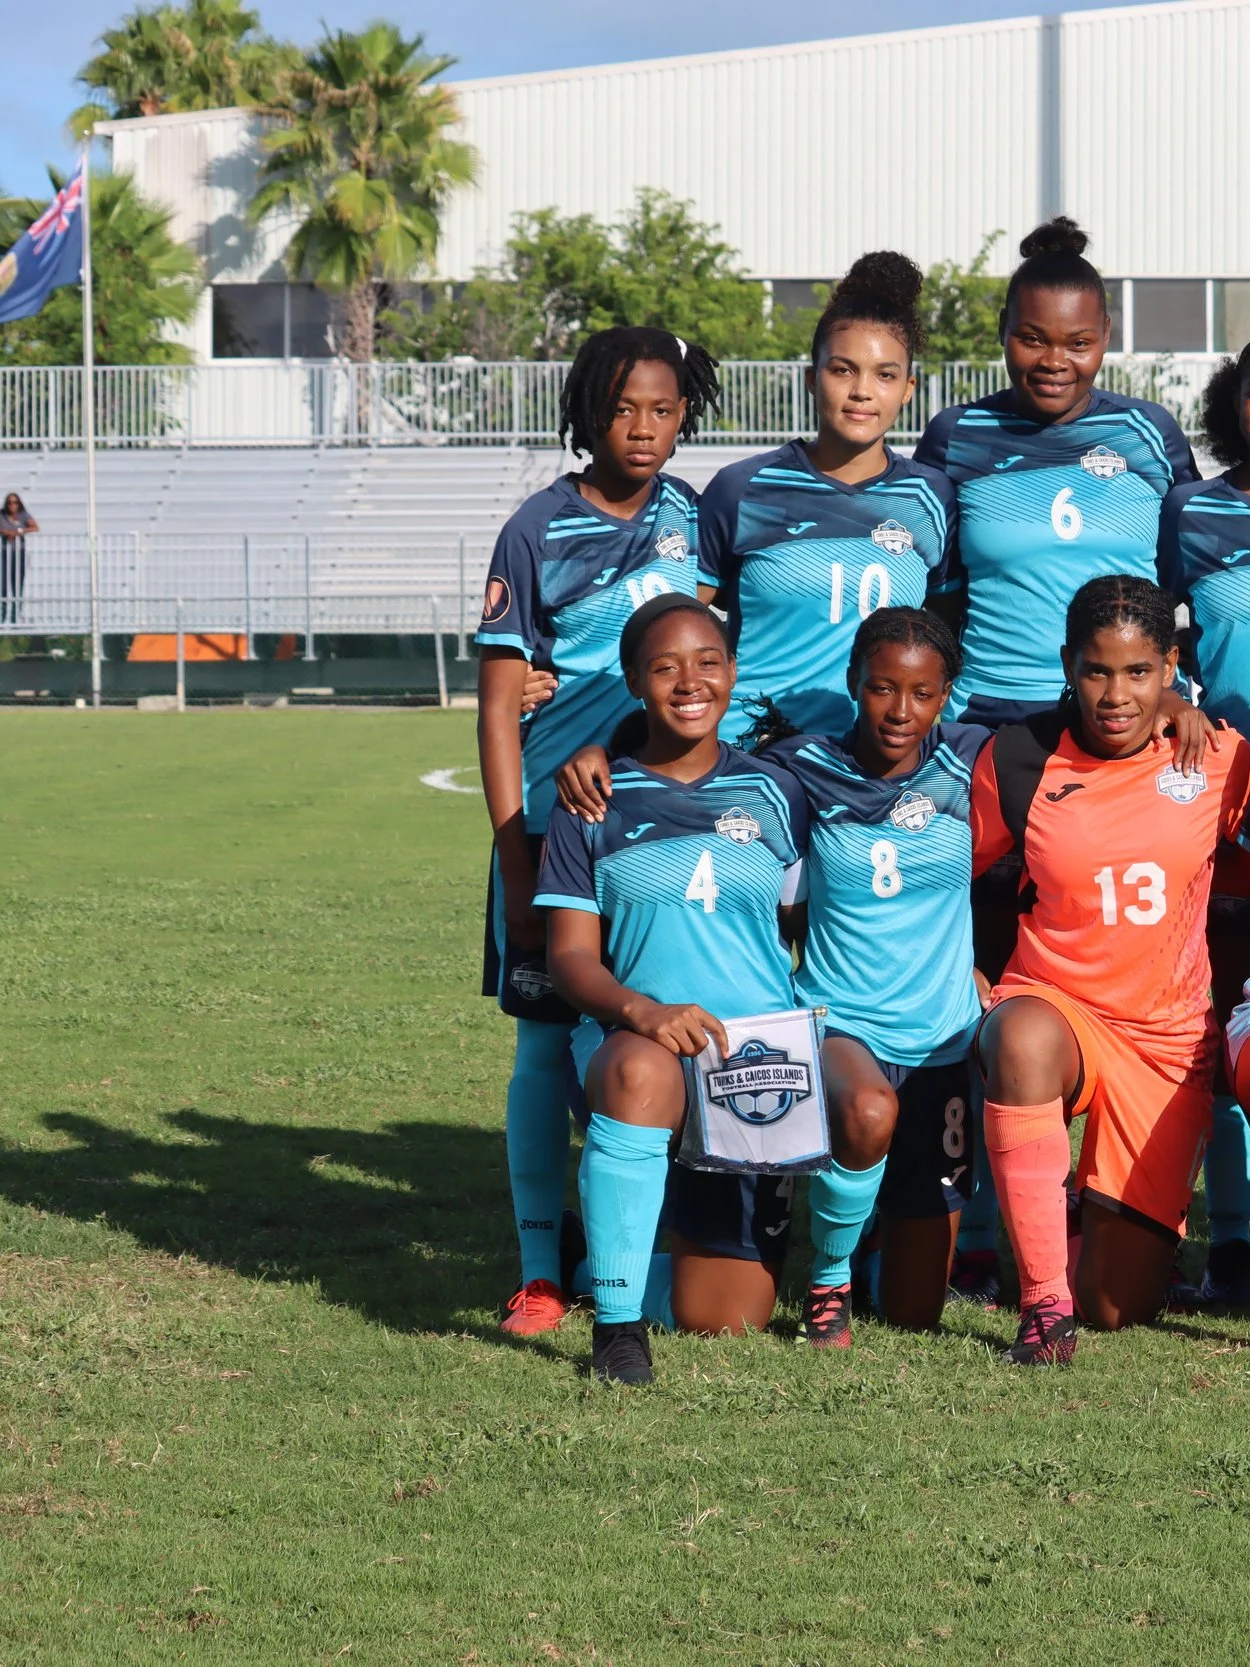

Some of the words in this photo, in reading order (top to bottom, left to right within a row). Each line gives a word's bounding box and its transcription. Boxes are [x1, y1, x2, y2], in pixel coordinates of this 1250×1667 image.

[1051, 487, 1083, 541] 6
[829, 562, 891, 624] 10
[685, 850, 720, 913] 4
[870, 839, 903, 898] 8
[1094, 861, 1167, 926] 13
[713, 1074, 735, 1087] TURKS
[736, 1073, 744, 1084] &
[745, 1069, 772, 1083] CAICOS
[772, 1067, 804, 1081] ISLANDS
[722, 1083, 753, 1091] FOOTBALL
[942, 1096, 966, 1158] 8
